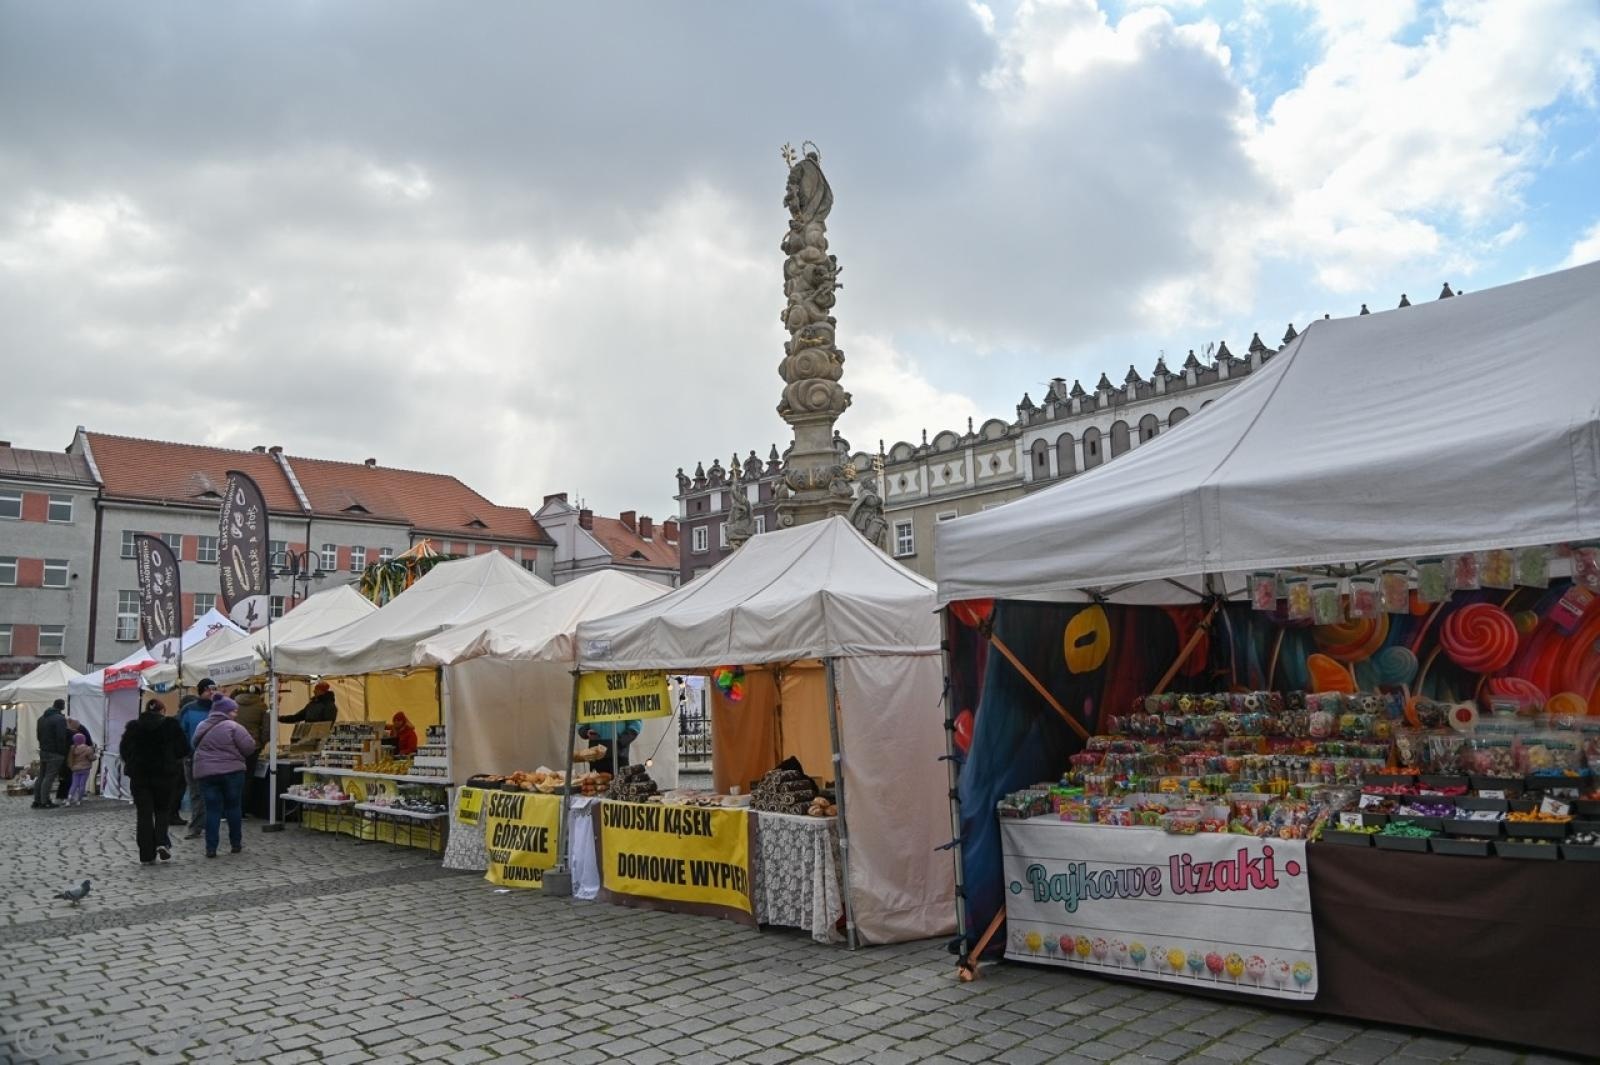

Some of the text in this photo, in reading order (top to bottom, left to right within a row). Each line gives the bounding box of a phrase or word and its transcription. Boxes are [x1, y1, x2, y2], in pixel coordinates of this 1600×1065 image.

[606, 673, 628, 691] SERY
[584, 693, 661, 719] WĘDZONE DYMEM
[488, 793, 526, 820] SERKI
[603, 803, 714, 839] SWOJSKI KĄSEK
[492, 819, 549, 854] GÓRSKIE
[617, 852, 687, 886] DOMOWE
[1026, 845, 1279, 913] Bajkowe lizaki
